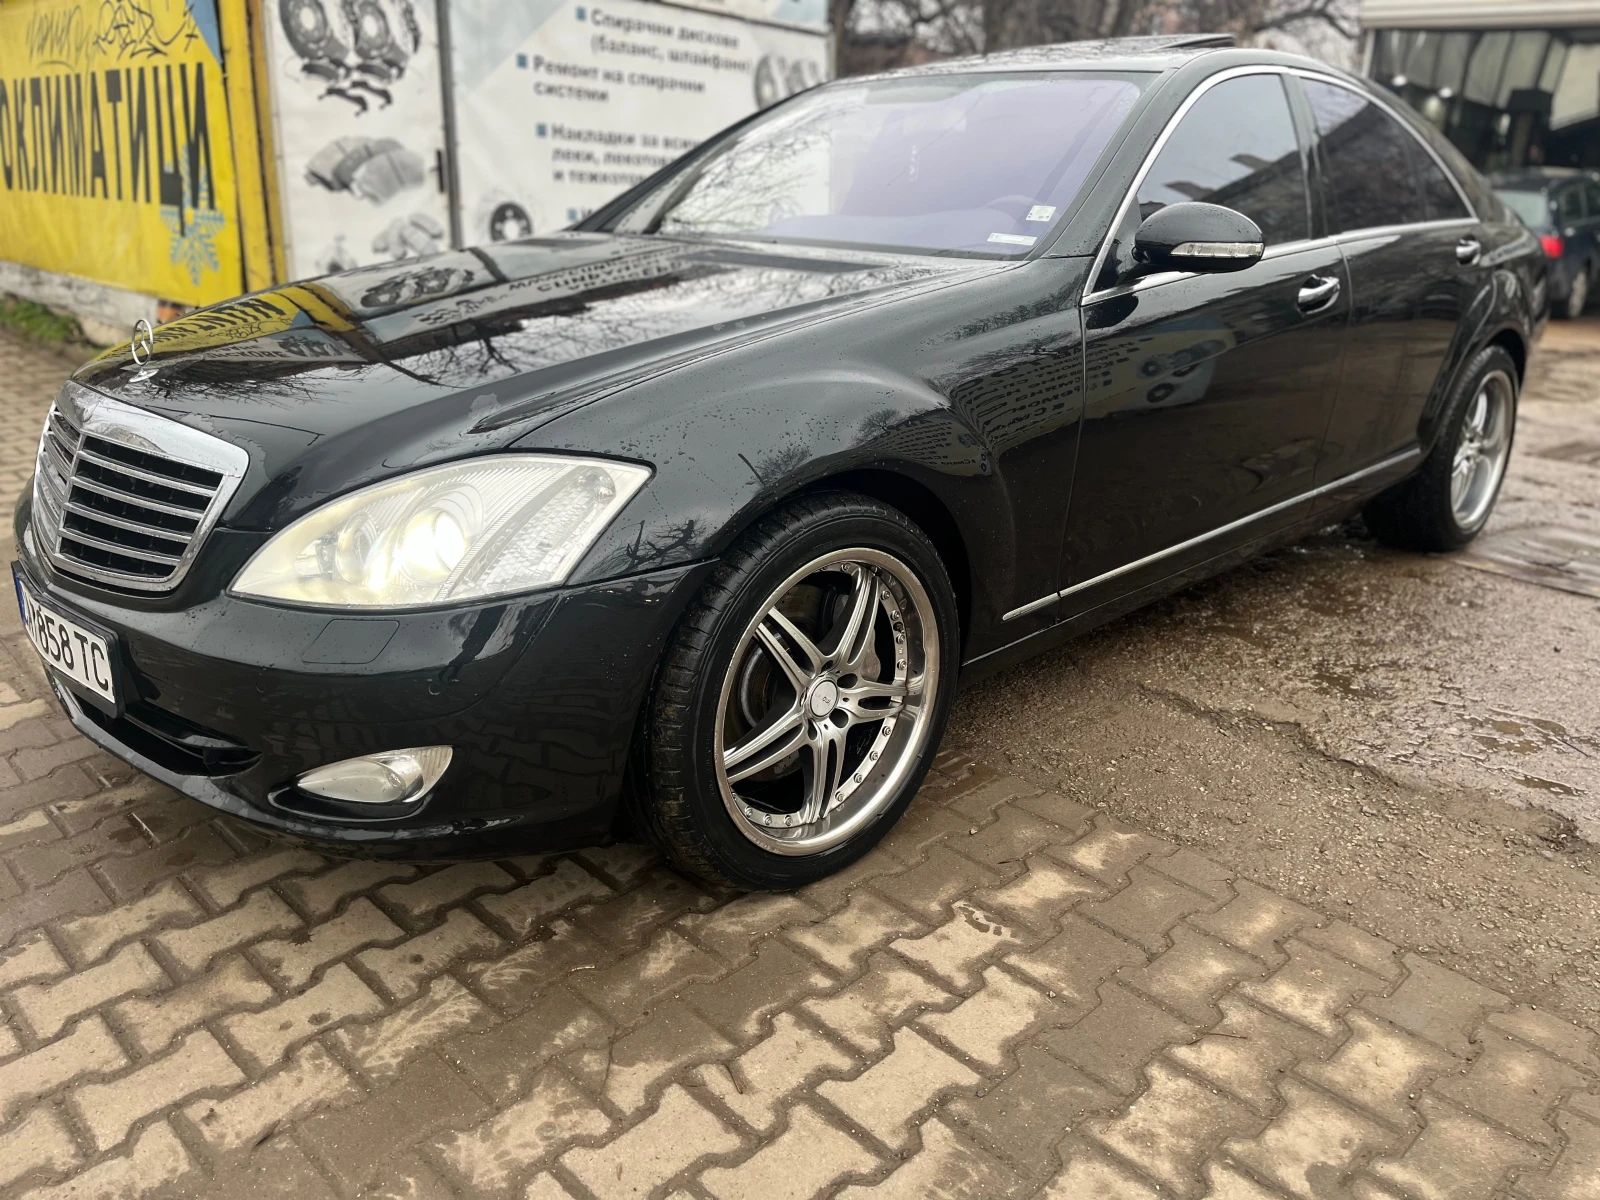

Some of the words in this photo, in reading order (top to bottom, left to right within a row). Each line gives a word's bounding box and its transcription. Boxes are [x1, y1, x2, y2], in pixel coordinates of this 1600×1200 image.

[591, 9, 674, 37] Спирачни
[678, 27, 740, 50] дискове
[533, 55, 599, 81] Ремонт
[604, 68, 624, 83] на
[628, 69, 706, 95] спирачни
[534, 81, 609, 103] системи
[551, 124, 636, 145] Накладки
[642, 134, 659, 148] за
